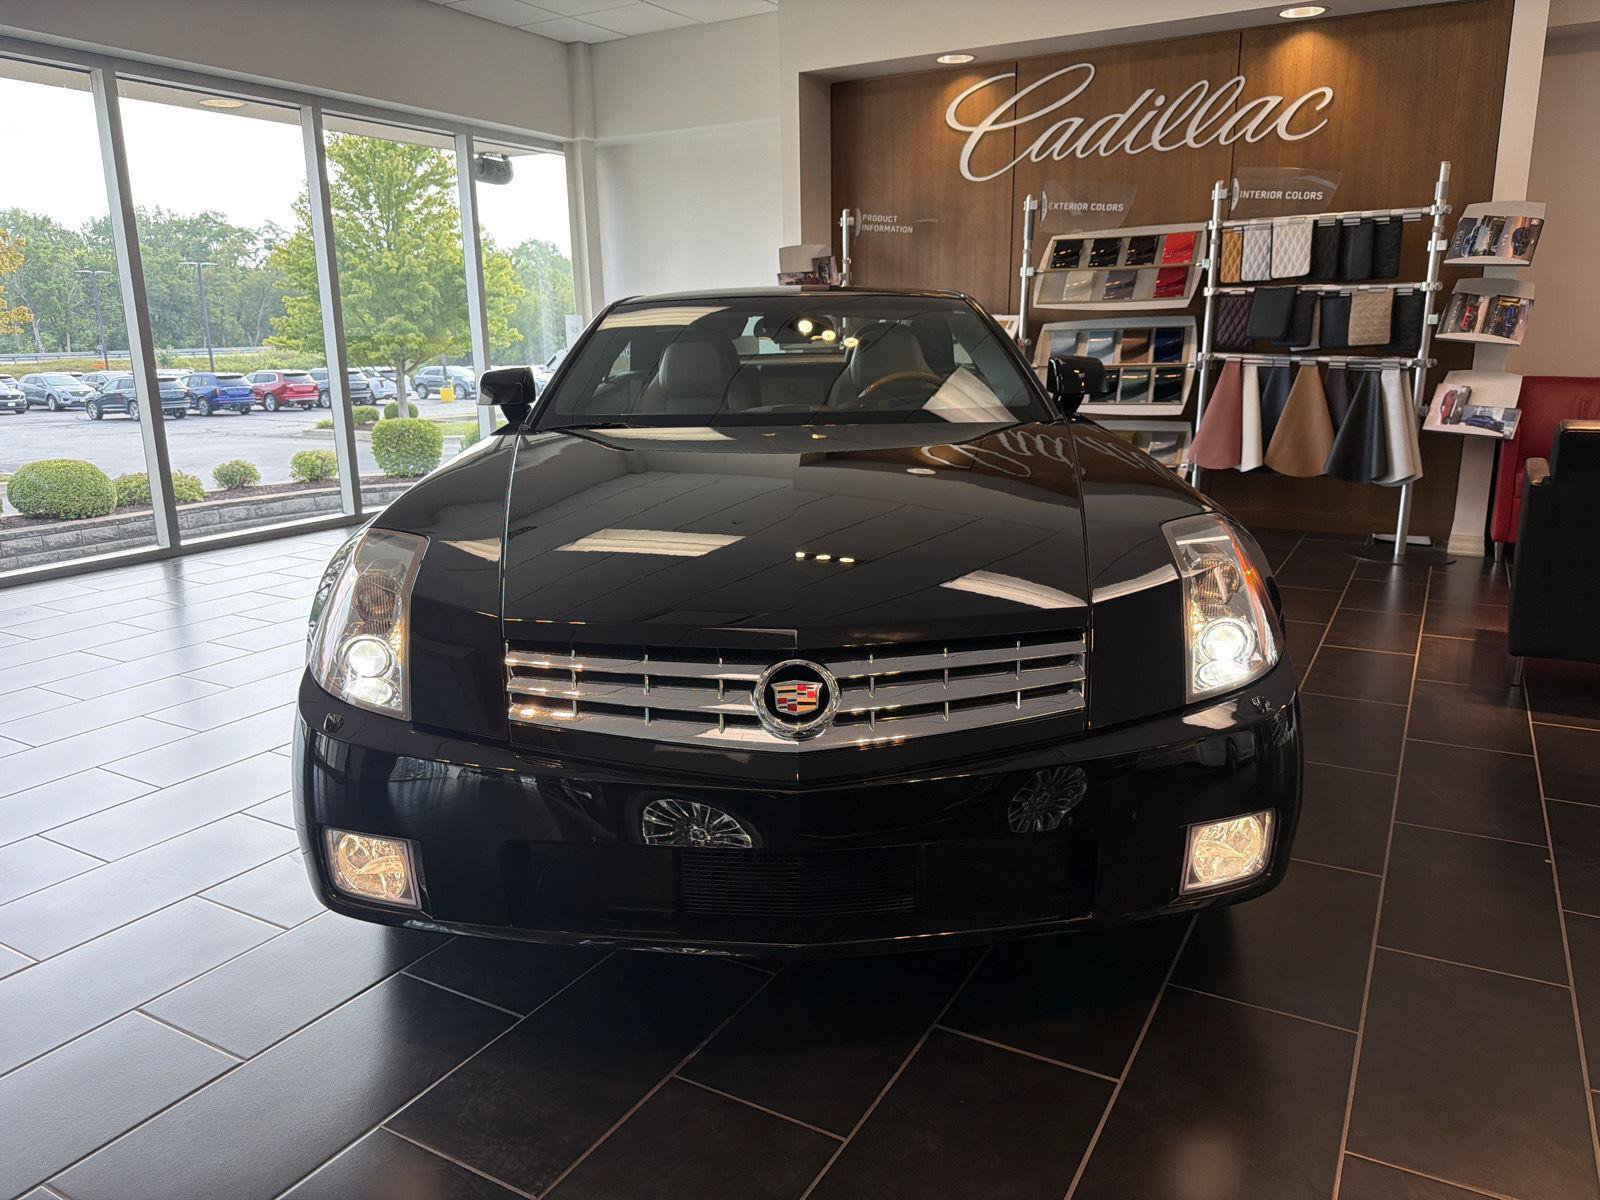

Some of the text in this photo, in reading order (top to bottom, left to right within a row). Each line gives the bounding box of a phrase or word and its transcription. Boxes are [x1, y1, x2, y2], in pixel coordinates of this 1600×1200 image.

[945, 62, 1334, 183] Cadillac
[1240, 190, 1324, 201] INTERIOR COLORS
[1048, 202, 1124, 212] EXTERIOR COLORS
[862, 214, 898, 223] PRODUCT
[862, 224, 913, 234] INFORMATION
